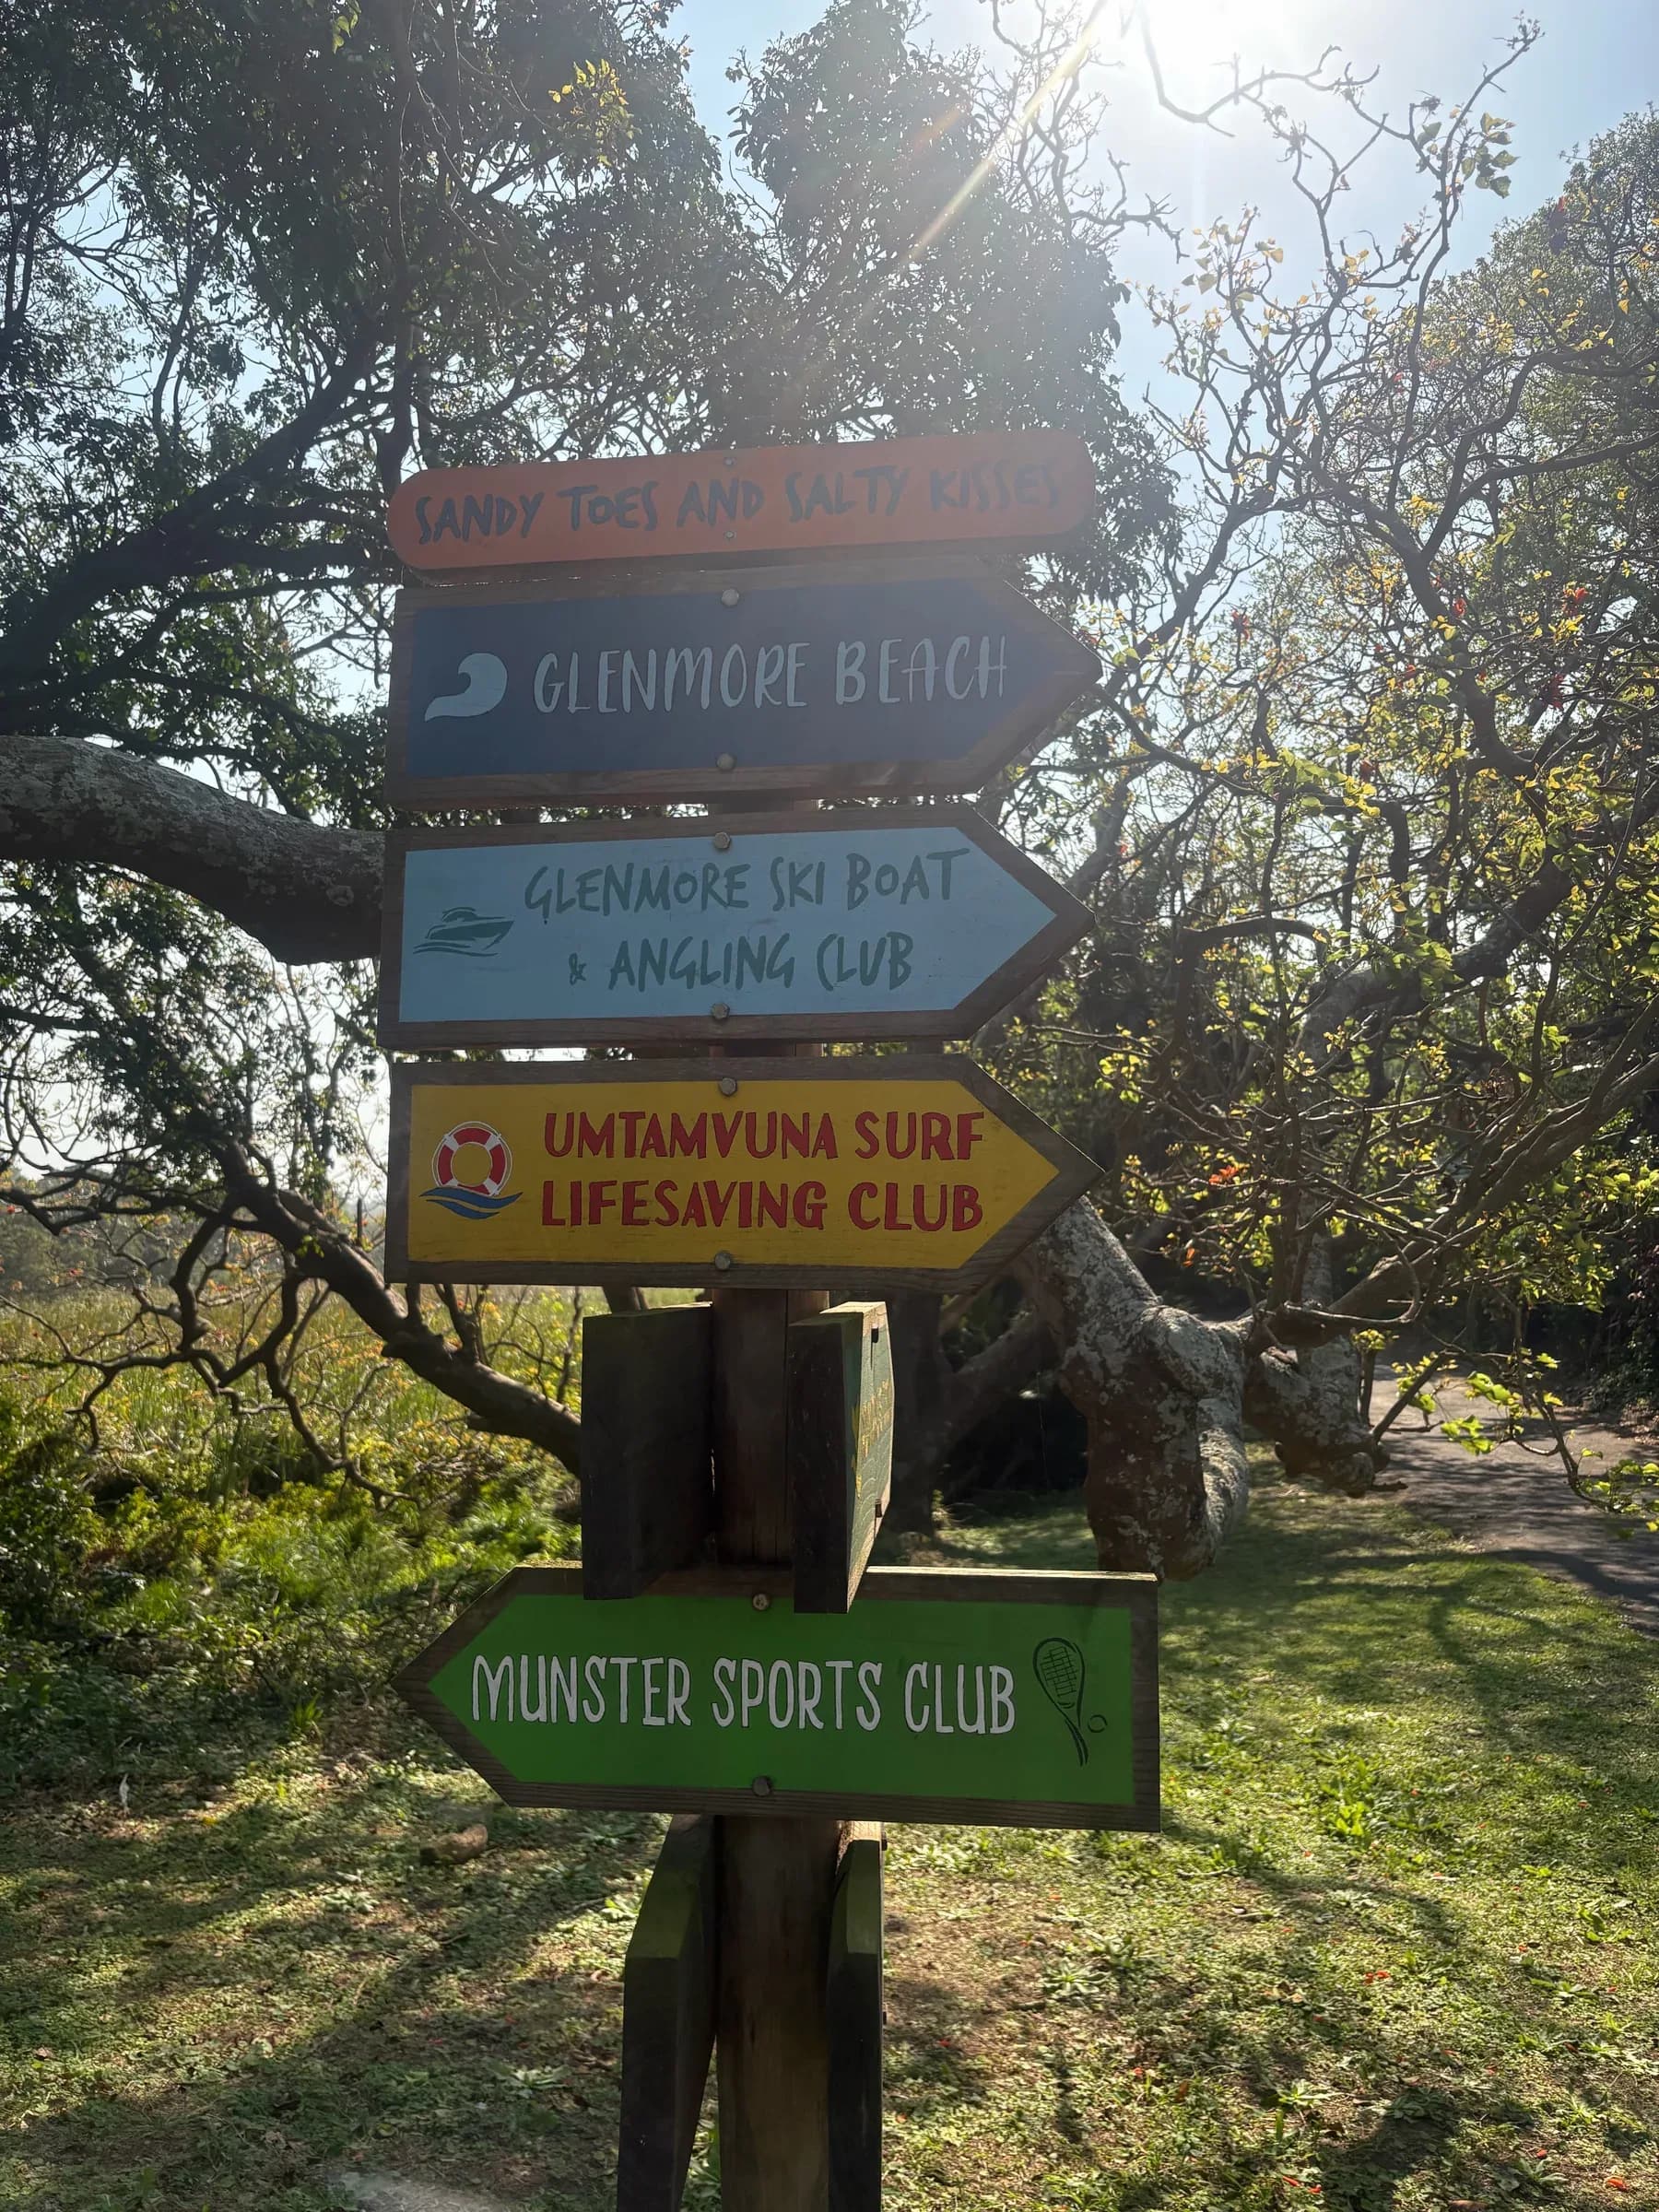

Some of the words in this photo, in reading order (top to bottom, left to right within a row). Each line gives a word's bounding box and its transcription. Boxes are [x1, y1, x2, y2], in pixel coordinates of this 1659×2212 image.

[416, 491, 544, 544] SANDY
[677, 477, 765, 528] AND
[784, 463, 909, 520] SALTY
[929, 458, 1059, 512] KISSES
[533, 641, 809, 713] GLENMORE
[836, 635, 1007, 704] BEACH
[524, 861, 749, 920] GLENMORE
[771, 857, 825, 911] SKI
[568, 953, 587, 984] &
[608, 934, 795, 993] ANGLING
[816, 932, 913, 991] CLUB
[544, 1111, 838, 1159] UMTAMVUNA
[854, 1111, 984, 1160] SURF
[542, 1181, 828, 1230] LIFESAVING
[847, 1182, 983, 1231] CLUB
[471, 1654, 692, 1727] MUNSTER
[712, 1658, 882, 1731] SPORTS
[903, 1662, 1016, 1735] CLUB
